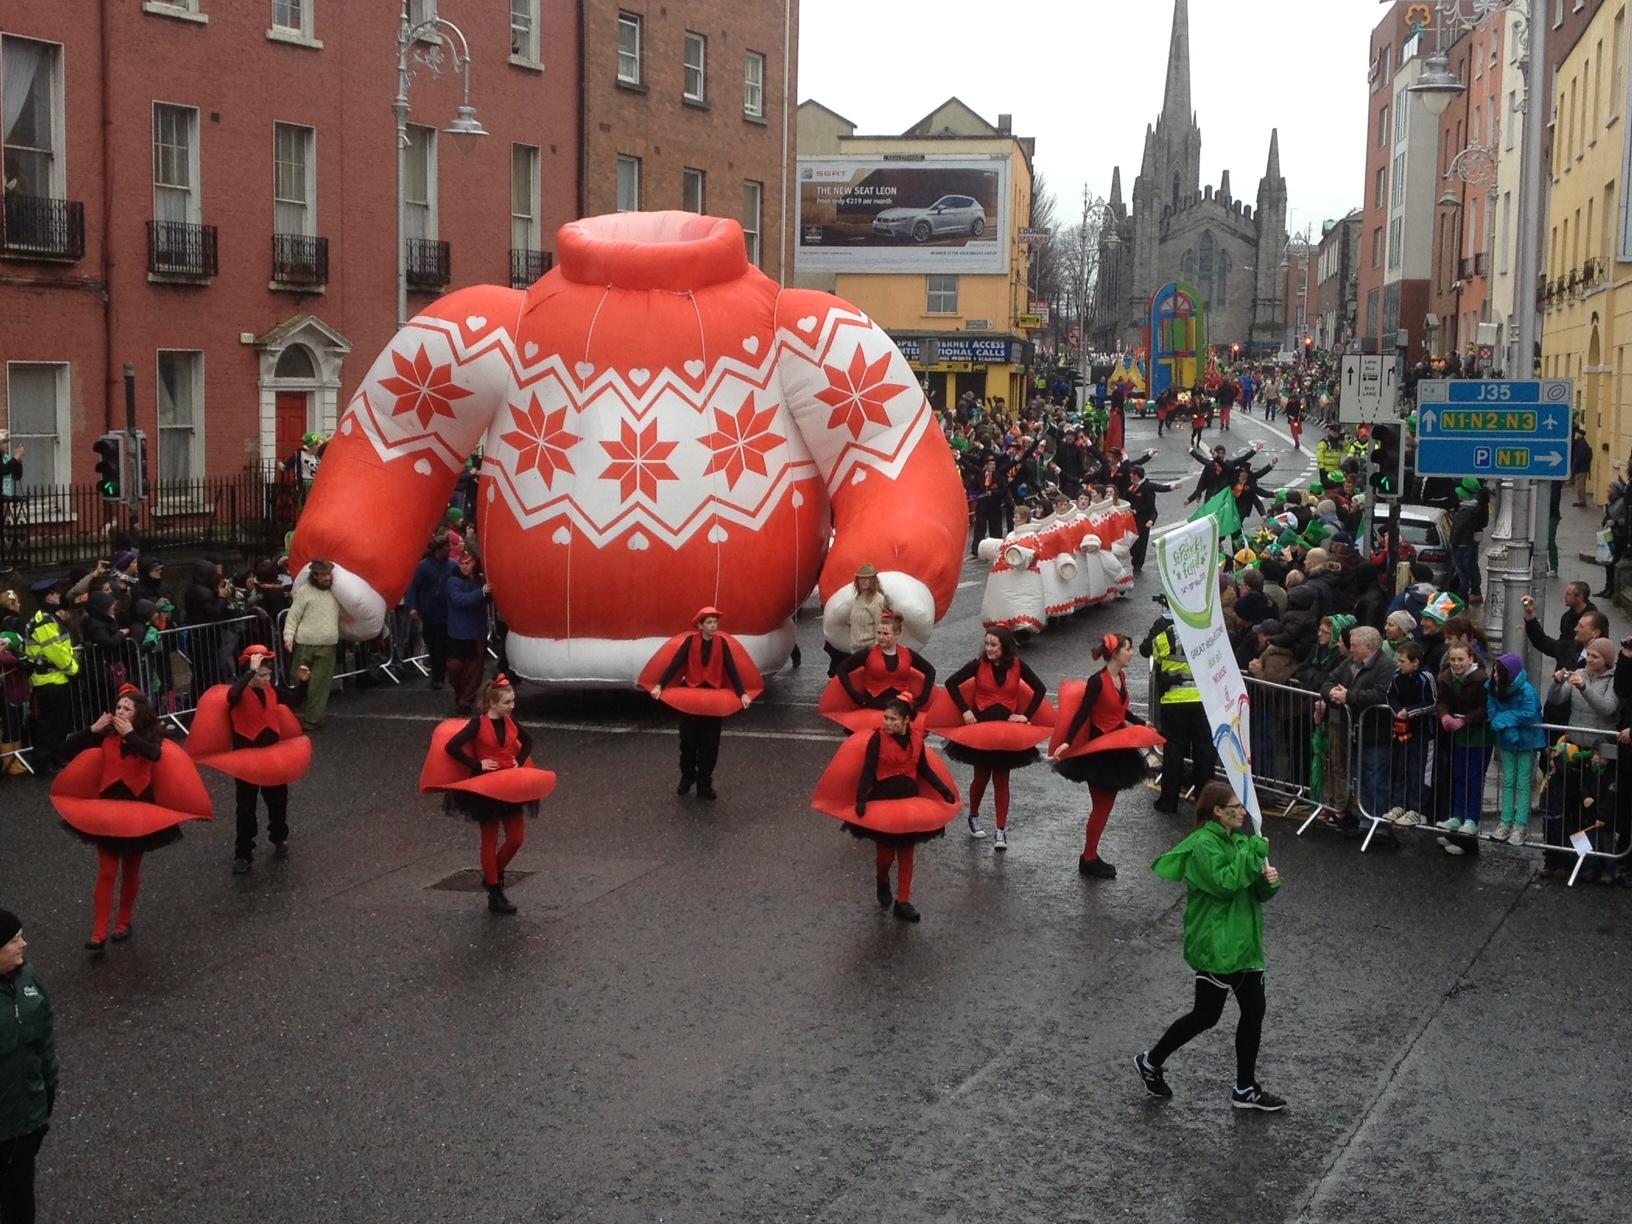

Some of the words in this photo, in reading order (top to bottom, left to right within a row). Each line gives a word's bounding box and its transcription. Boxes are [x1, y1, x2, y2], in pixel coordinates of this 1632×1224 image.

[816, 186, 832, 195] THE
[833, 186, 853, 195] NEW
[853, 186, 874, 195] SEAT
[875, 186, 898, 196] LEON
[845, 197, 862, 205] €219
[897, 341, 919, 349] SPEE
[972, 341, 1005, 349] ACCESS
[975, 349, 1005, 357] CALLS
[1477, 384, 1511, 401] J35
[1476, 449, 1488, 464] P
[1497, 450, 1528, 466] N11
